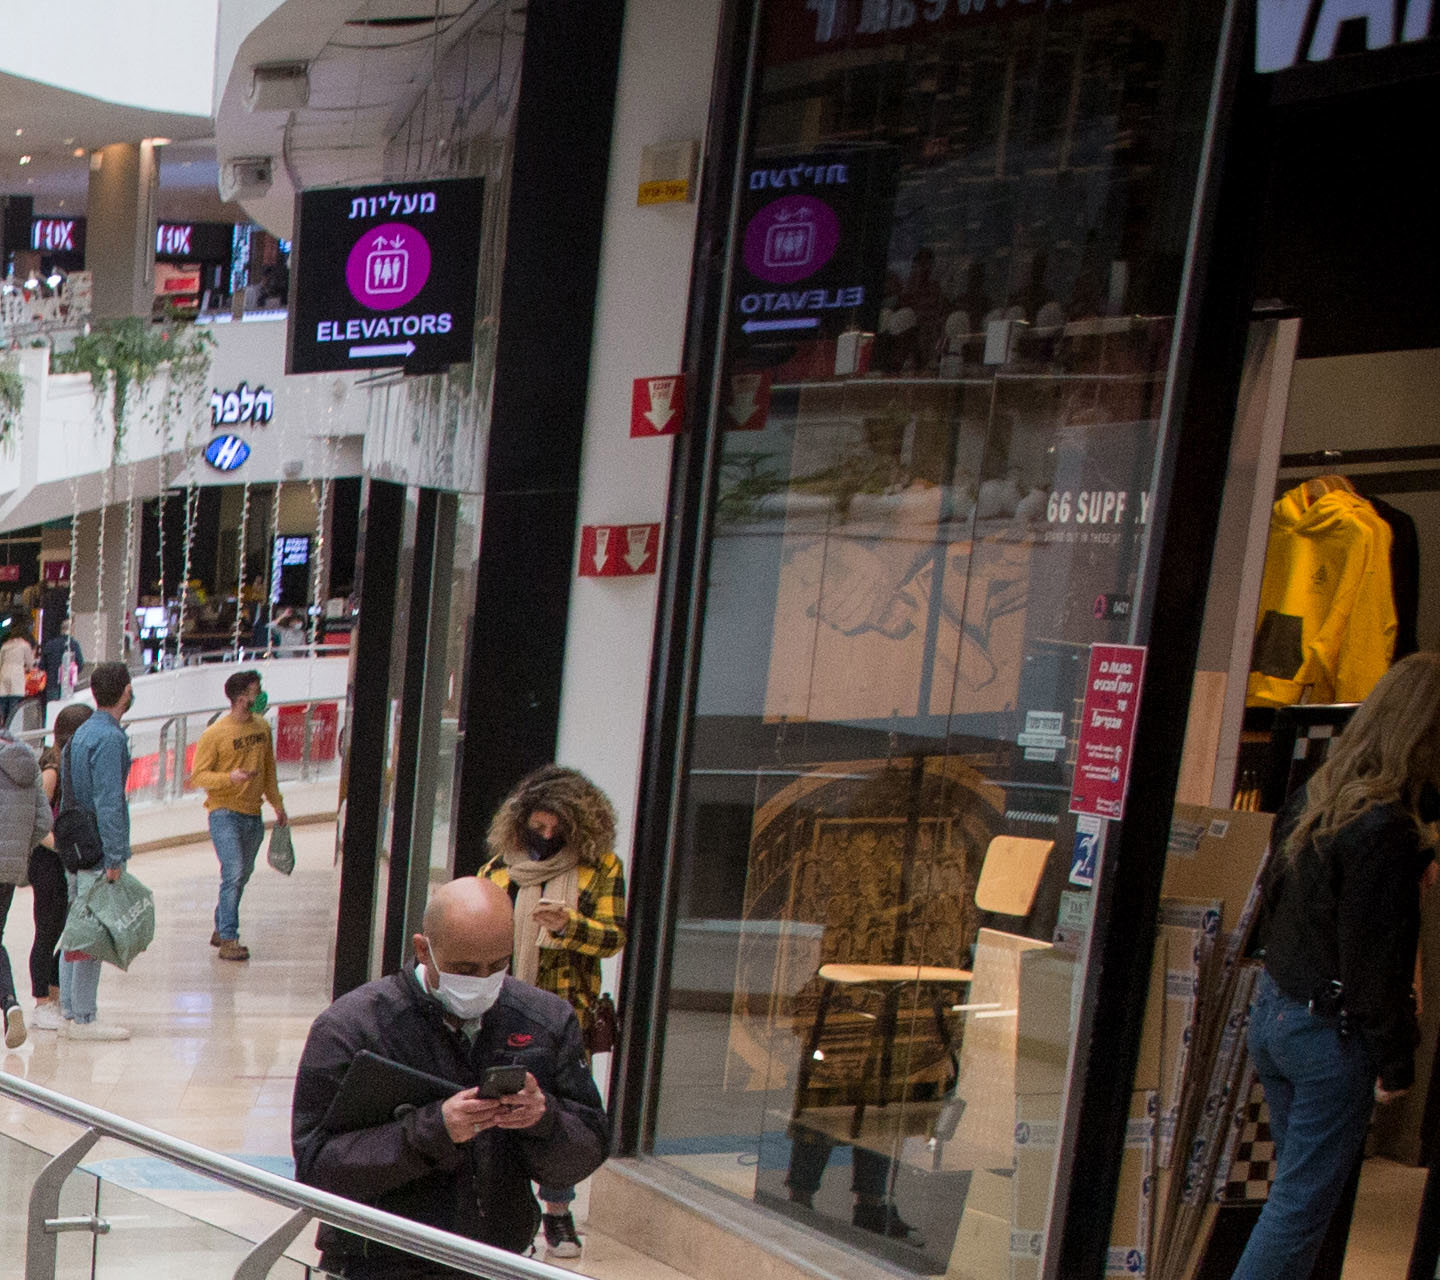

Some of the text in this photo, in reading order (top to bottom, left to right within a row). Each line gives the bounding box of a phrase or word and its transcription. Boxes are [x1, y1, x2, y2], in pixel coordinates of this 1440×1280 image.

[348, 192, 437, 219] מעליות
[33, 219, 76, 250] FOX
[156, 224, 192, 255] FOX
[316, 313, 453, 343] ELEVATORS
[1046, 490, 1072, 523] 66
